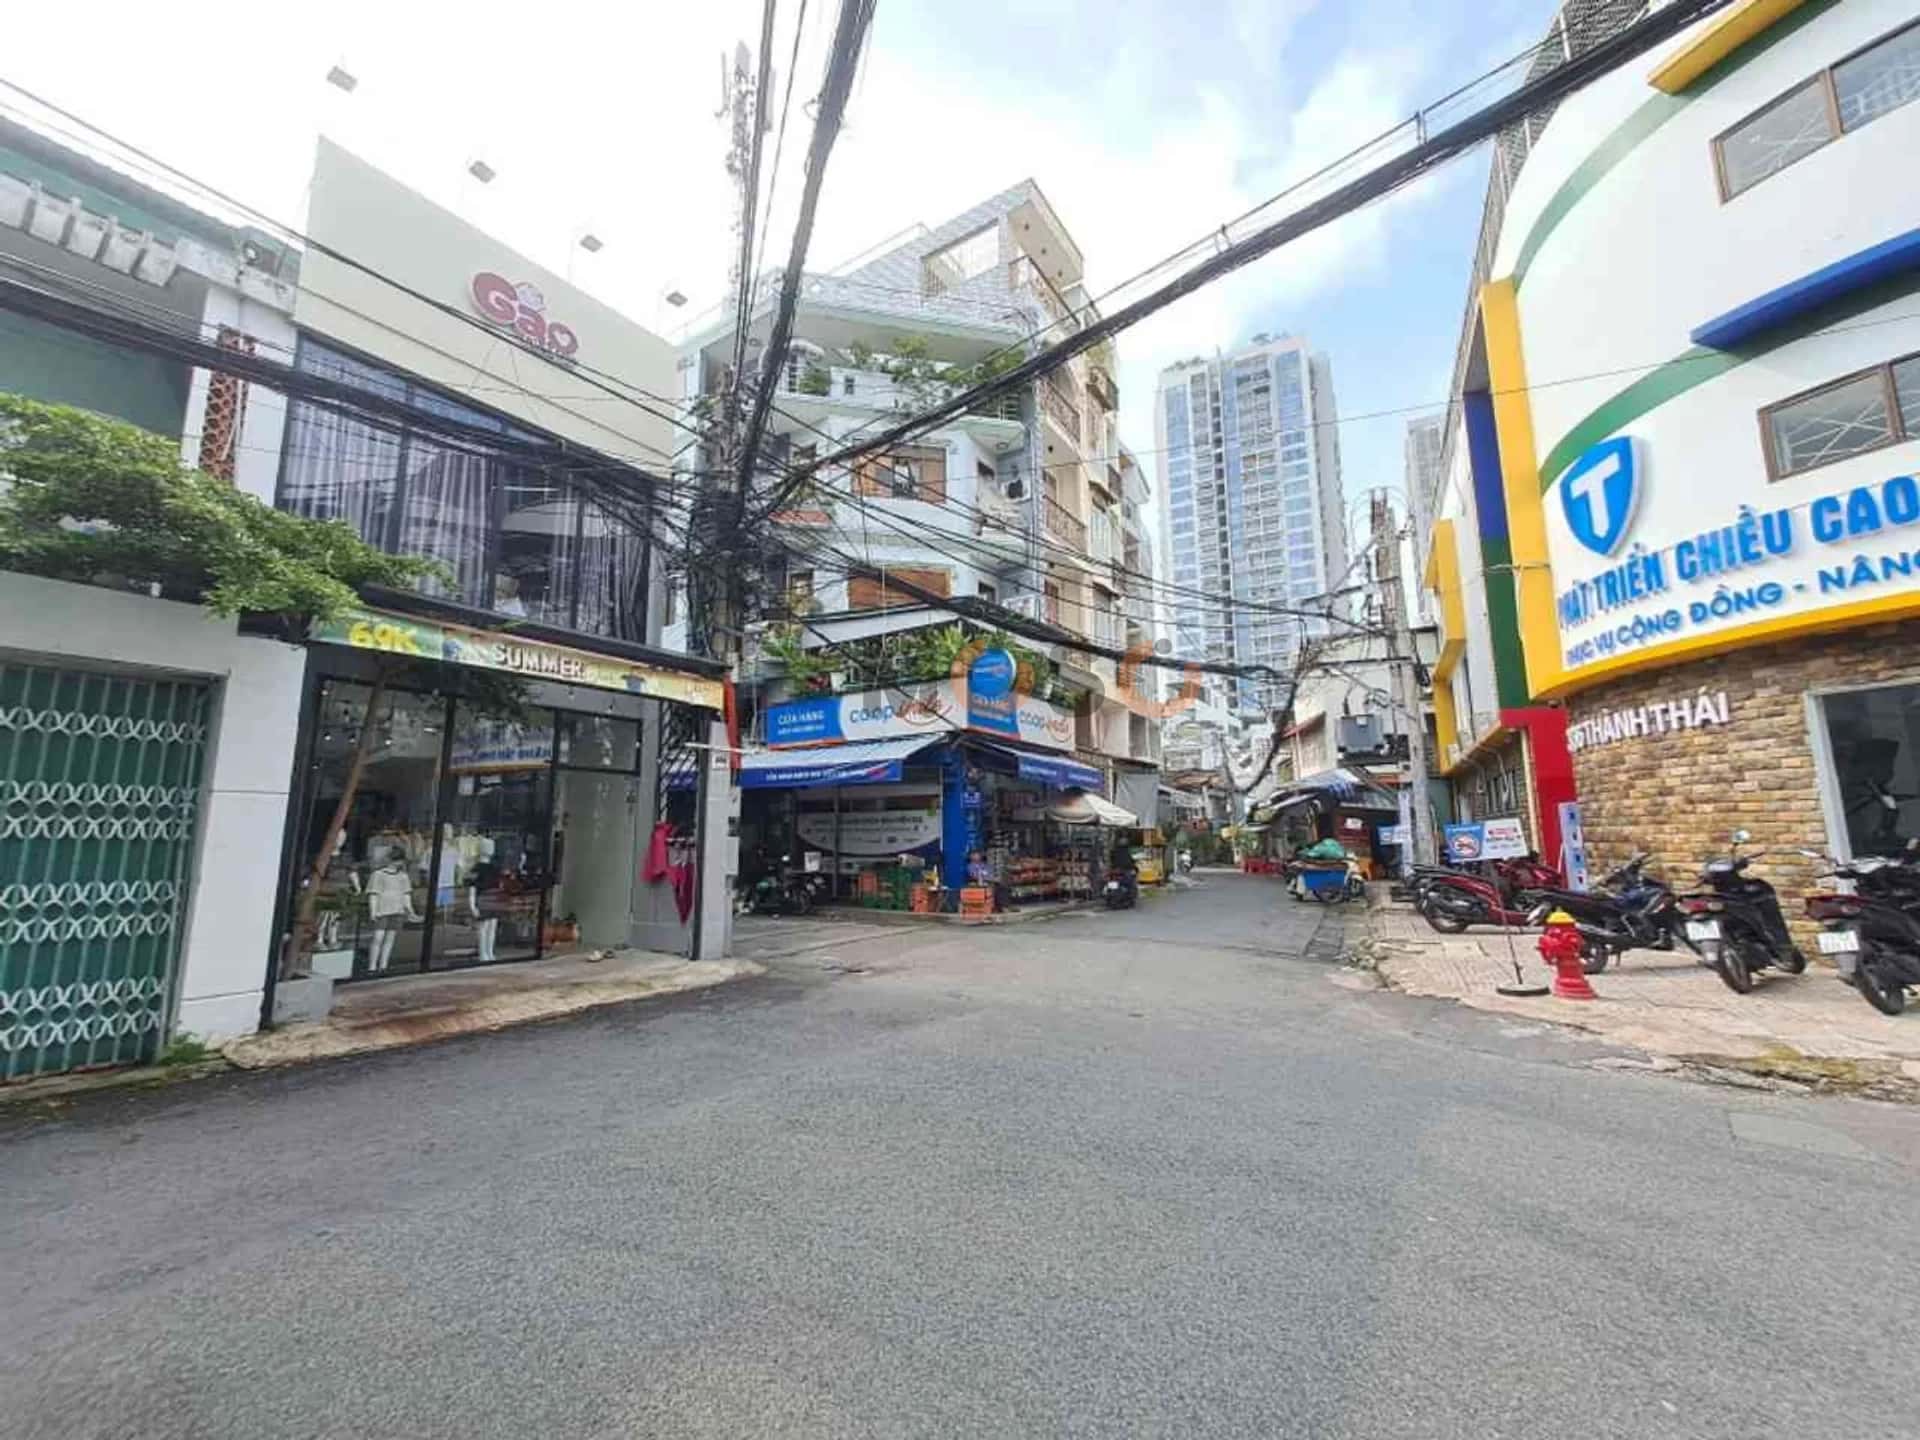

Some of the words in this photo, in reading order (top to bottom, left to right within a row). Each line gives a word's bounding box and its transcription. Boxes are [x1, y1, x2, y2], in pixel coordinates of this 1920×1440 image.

[1674, 504, 1792, 583] CHIỀU
[1810, 475, 1920, 543] CAO
[1615, 609, 1682, 647] CỘNG
[1689, 582, 1783, 625] ĐỒNG
[1817, 549, 1920, 593] NÂN
[1649, 685, 1728, 734] THÁI
